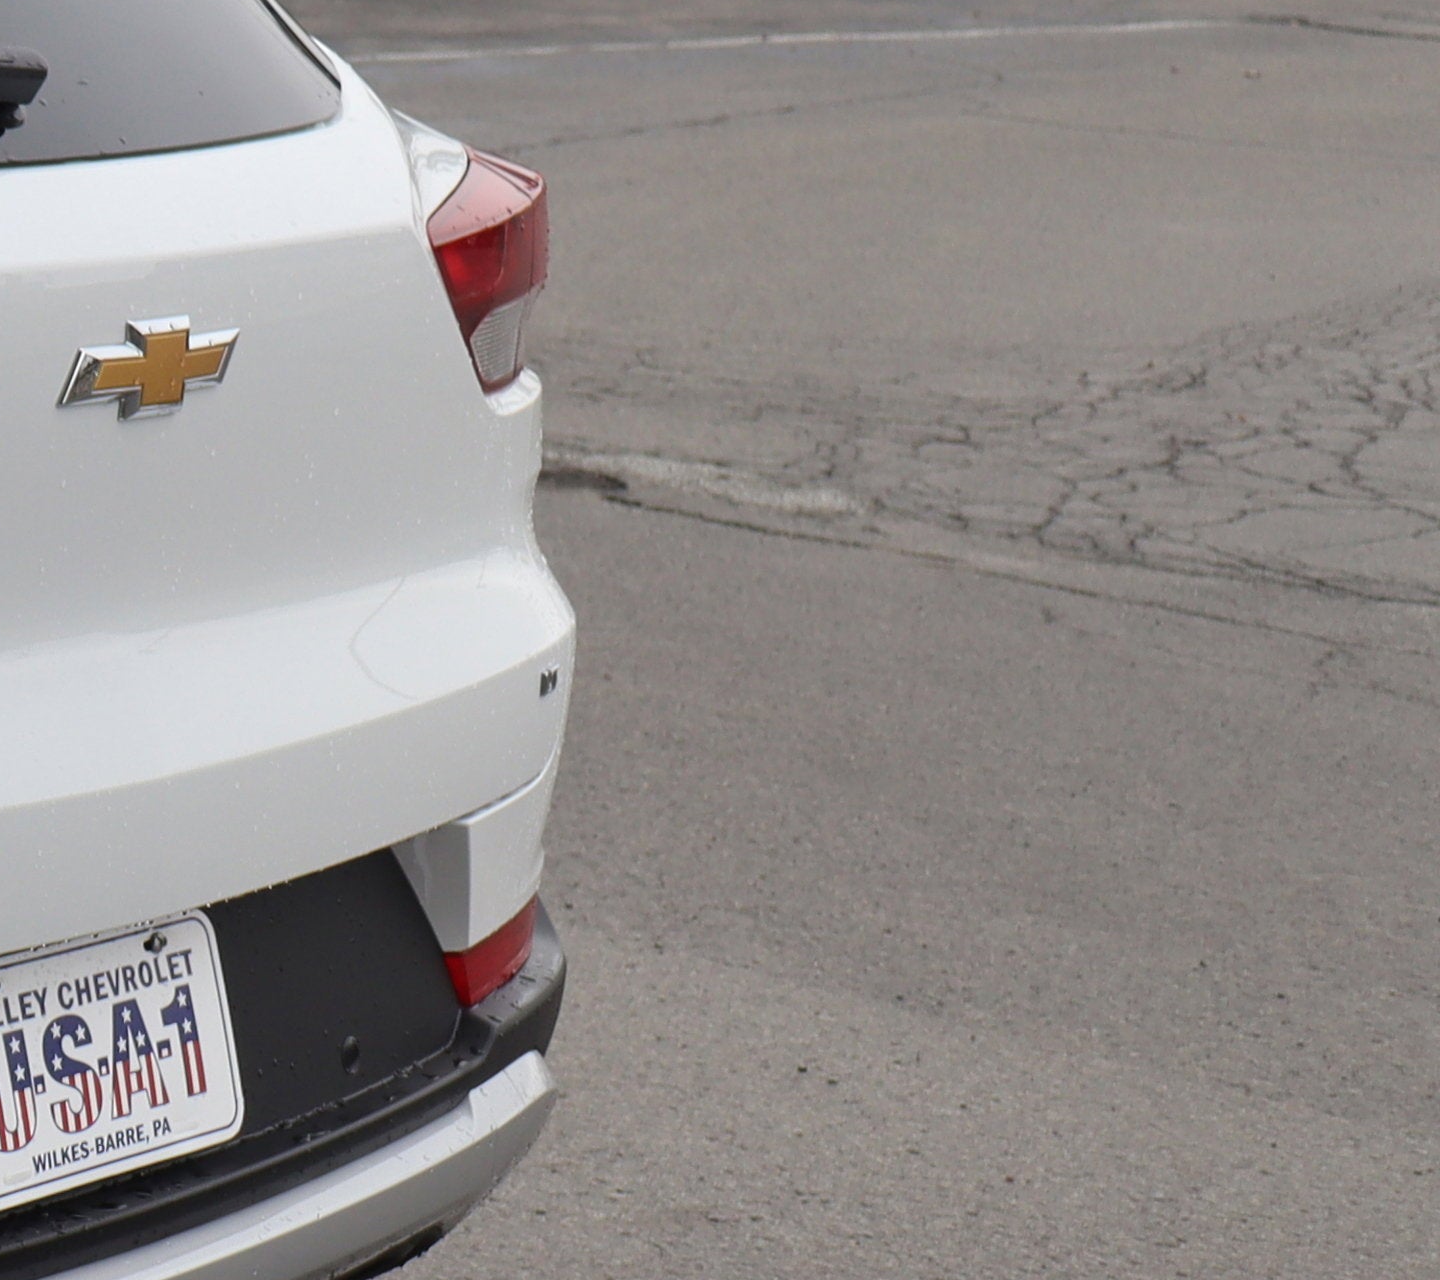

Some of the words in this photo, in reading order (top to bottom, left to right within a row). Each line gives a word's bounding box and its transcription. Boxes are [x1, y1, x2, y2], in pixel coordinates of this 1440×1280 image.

[57, 948, 194, 1010] CHEVROLET
[32, 1123, 151, 1174] WILKES-BARRE,
[153, 1116, 172, 1138] PA
